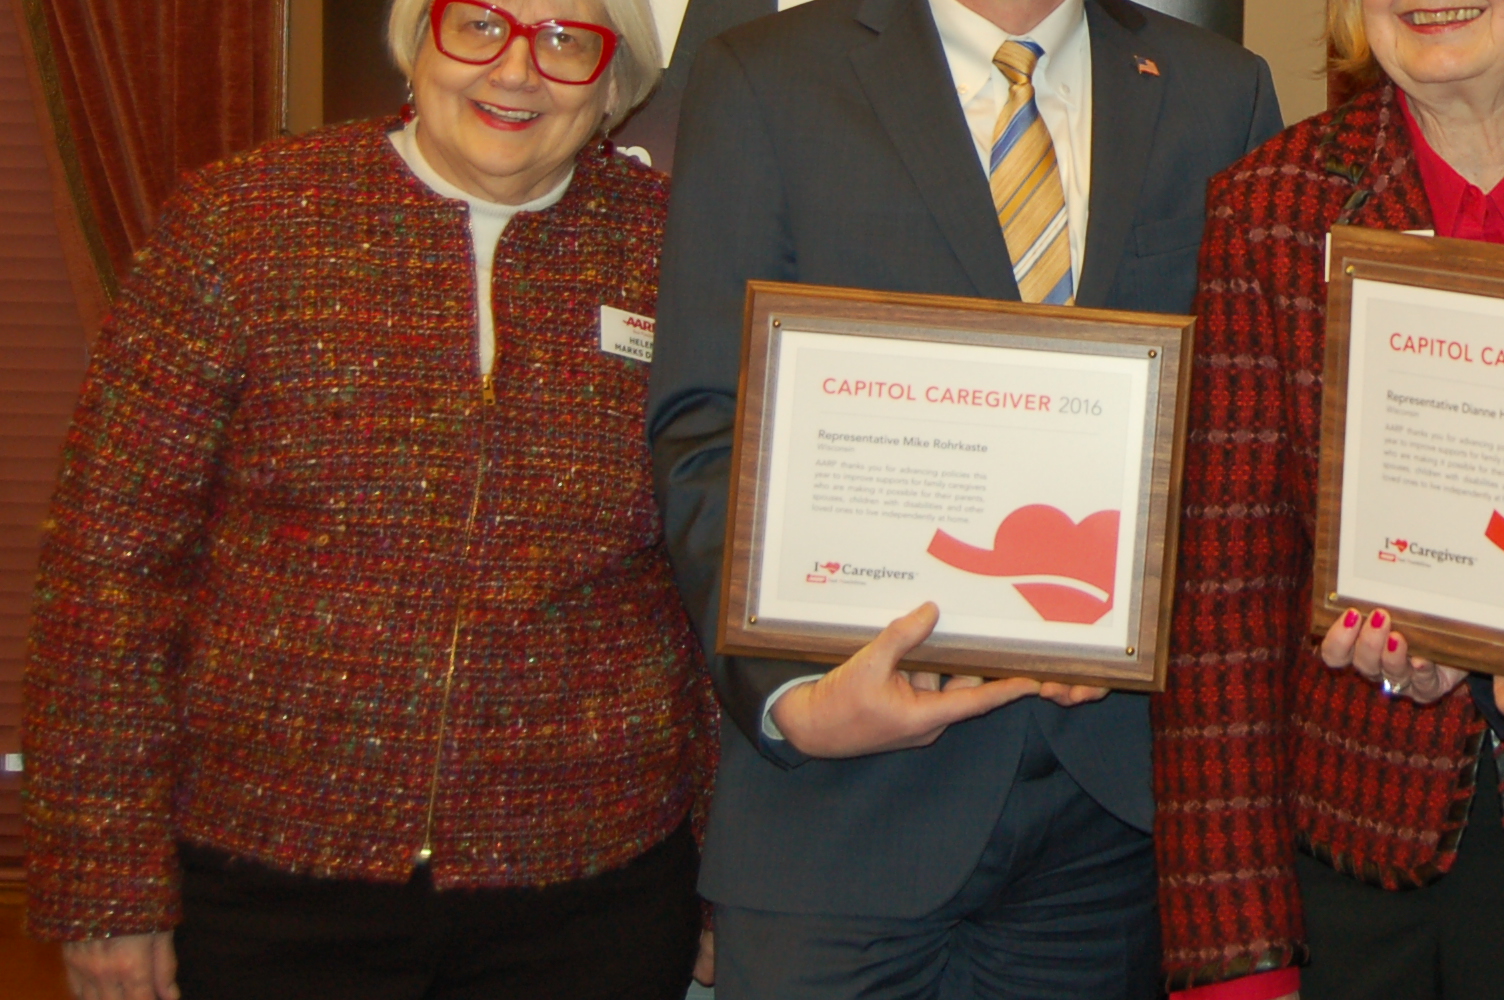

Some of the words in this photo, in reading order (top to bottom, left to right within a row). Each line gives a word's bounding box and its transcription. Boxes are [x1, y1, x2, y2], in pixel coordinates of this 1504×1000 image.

[1390, 333, 1473, 363] CAPITOL
[822, 377, 916, 401] CAPITOL
[925, 385, 1051, 412] CAREGIVER
[1058, 396, 1103, 416] 2016
[1387, 390, 1458, 411] Representative
[1462, 403, 1496, 418] Dianne
[818, 429, 899, 445] Representative
[903, 437, 929, 448] Mike
[933, 439, 988, 452] Rohrkaste
[1409, 542, 1474, 566] Caregivers
[842, 563, 914, 580] Caregivers
